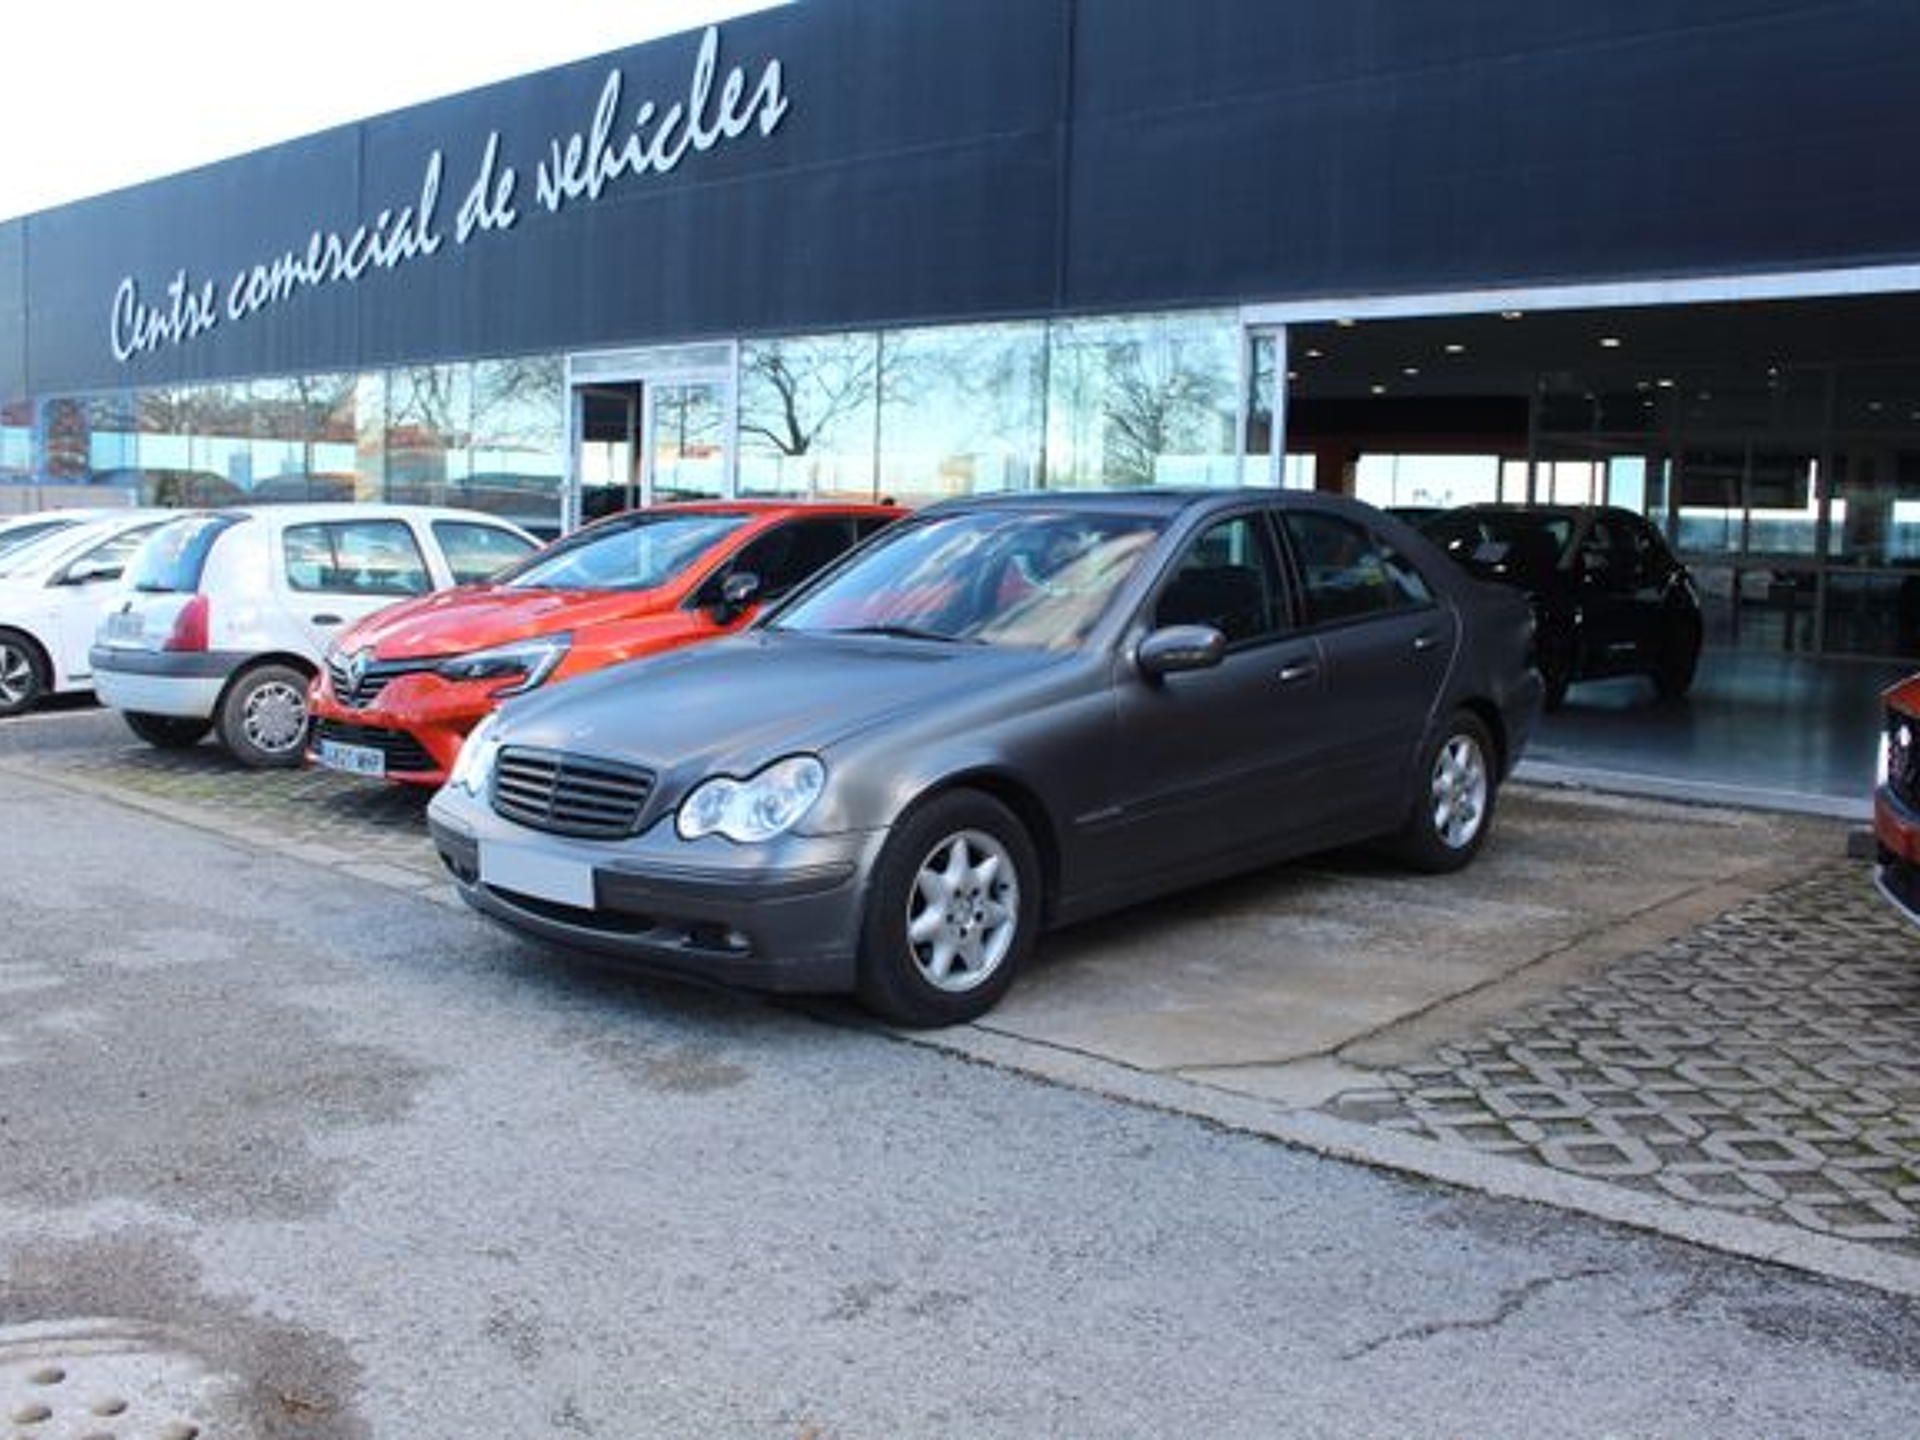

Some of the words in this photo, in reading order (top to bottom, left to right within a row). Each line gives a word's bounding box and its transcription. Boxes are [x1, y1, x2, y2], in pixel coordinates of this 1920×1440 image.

[110, 271, 216, 362] Centre
[227, 150, 440, 320] comercial
[456, 132, 516, 243] de
[537, 26, 788, 209] vehicles
